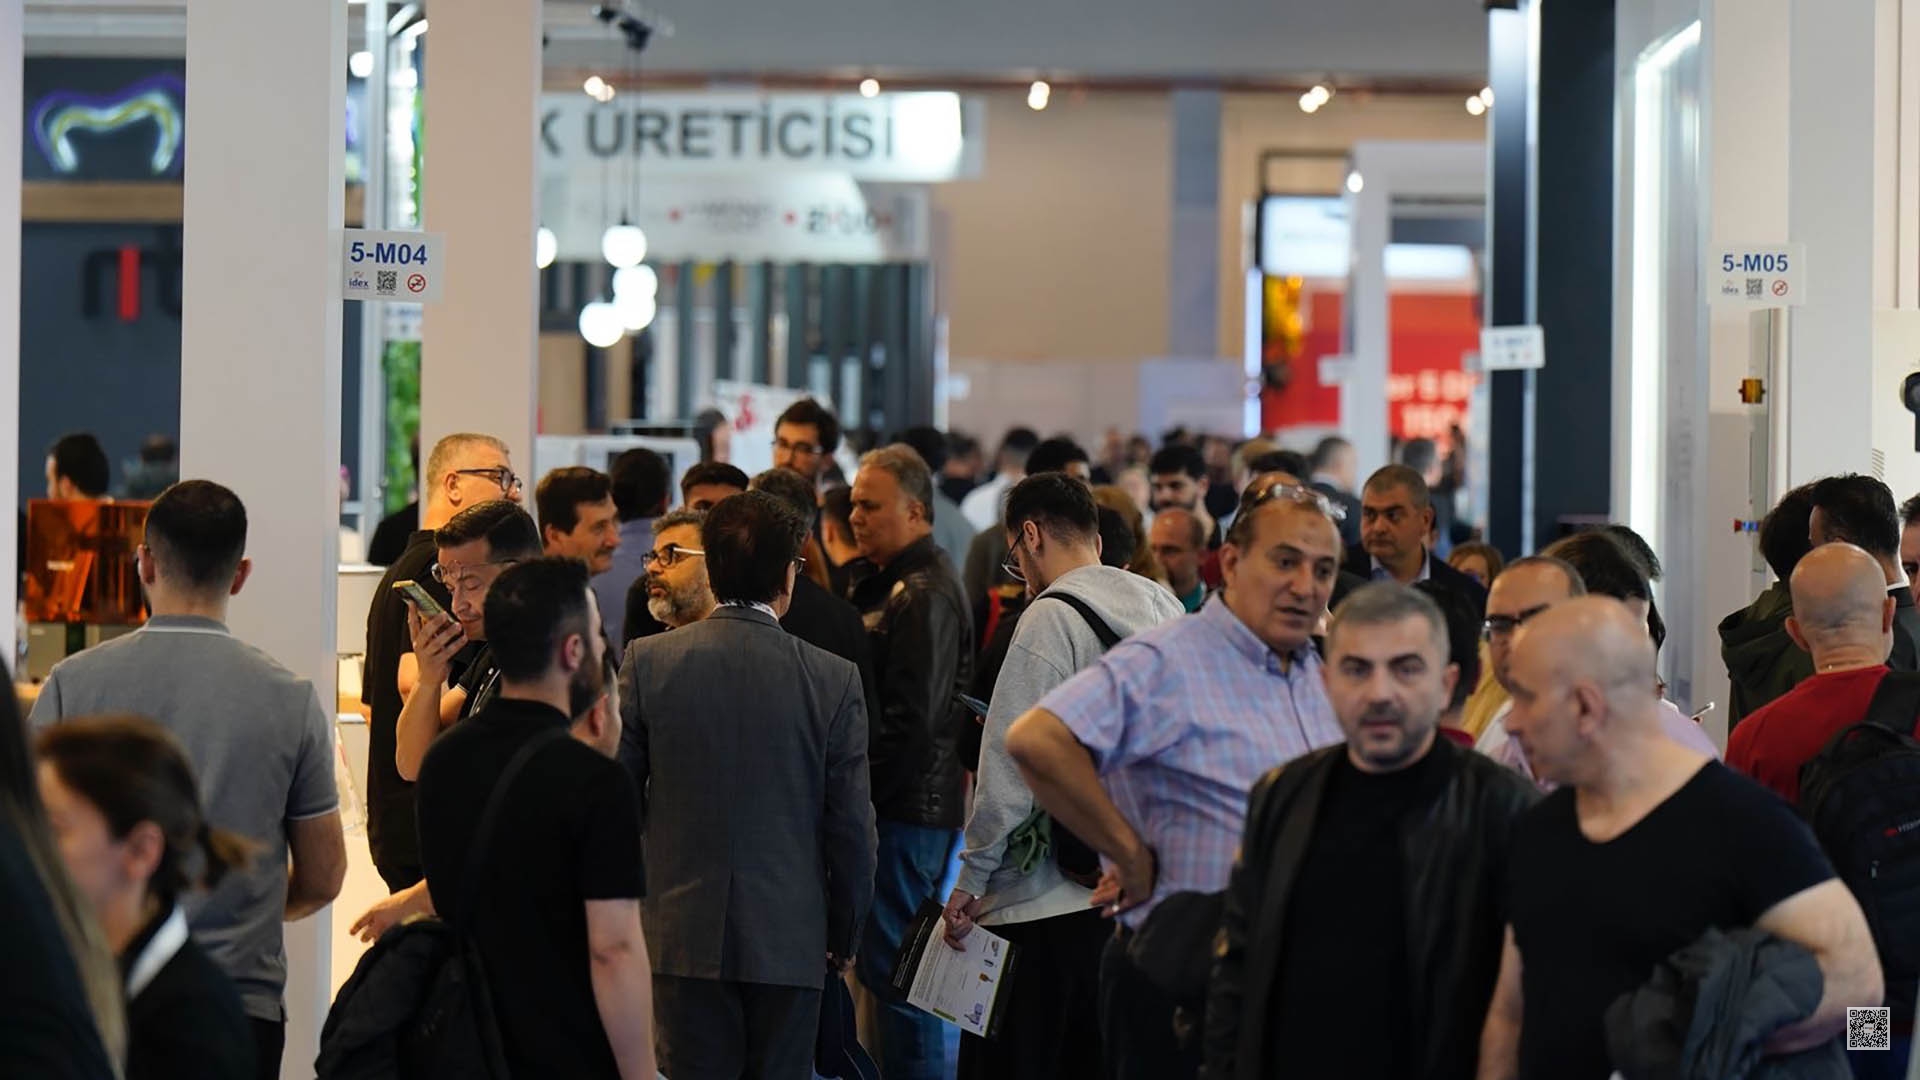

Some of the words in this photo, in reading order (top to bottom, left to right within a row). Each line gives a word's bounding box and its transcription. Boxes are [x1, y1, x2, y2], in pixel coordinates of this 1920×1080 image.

[350, 241, 428, 266] 5-M04
[1722, 253, 1789, 273] 5-M05
[348, 277, 370, 288] idex
